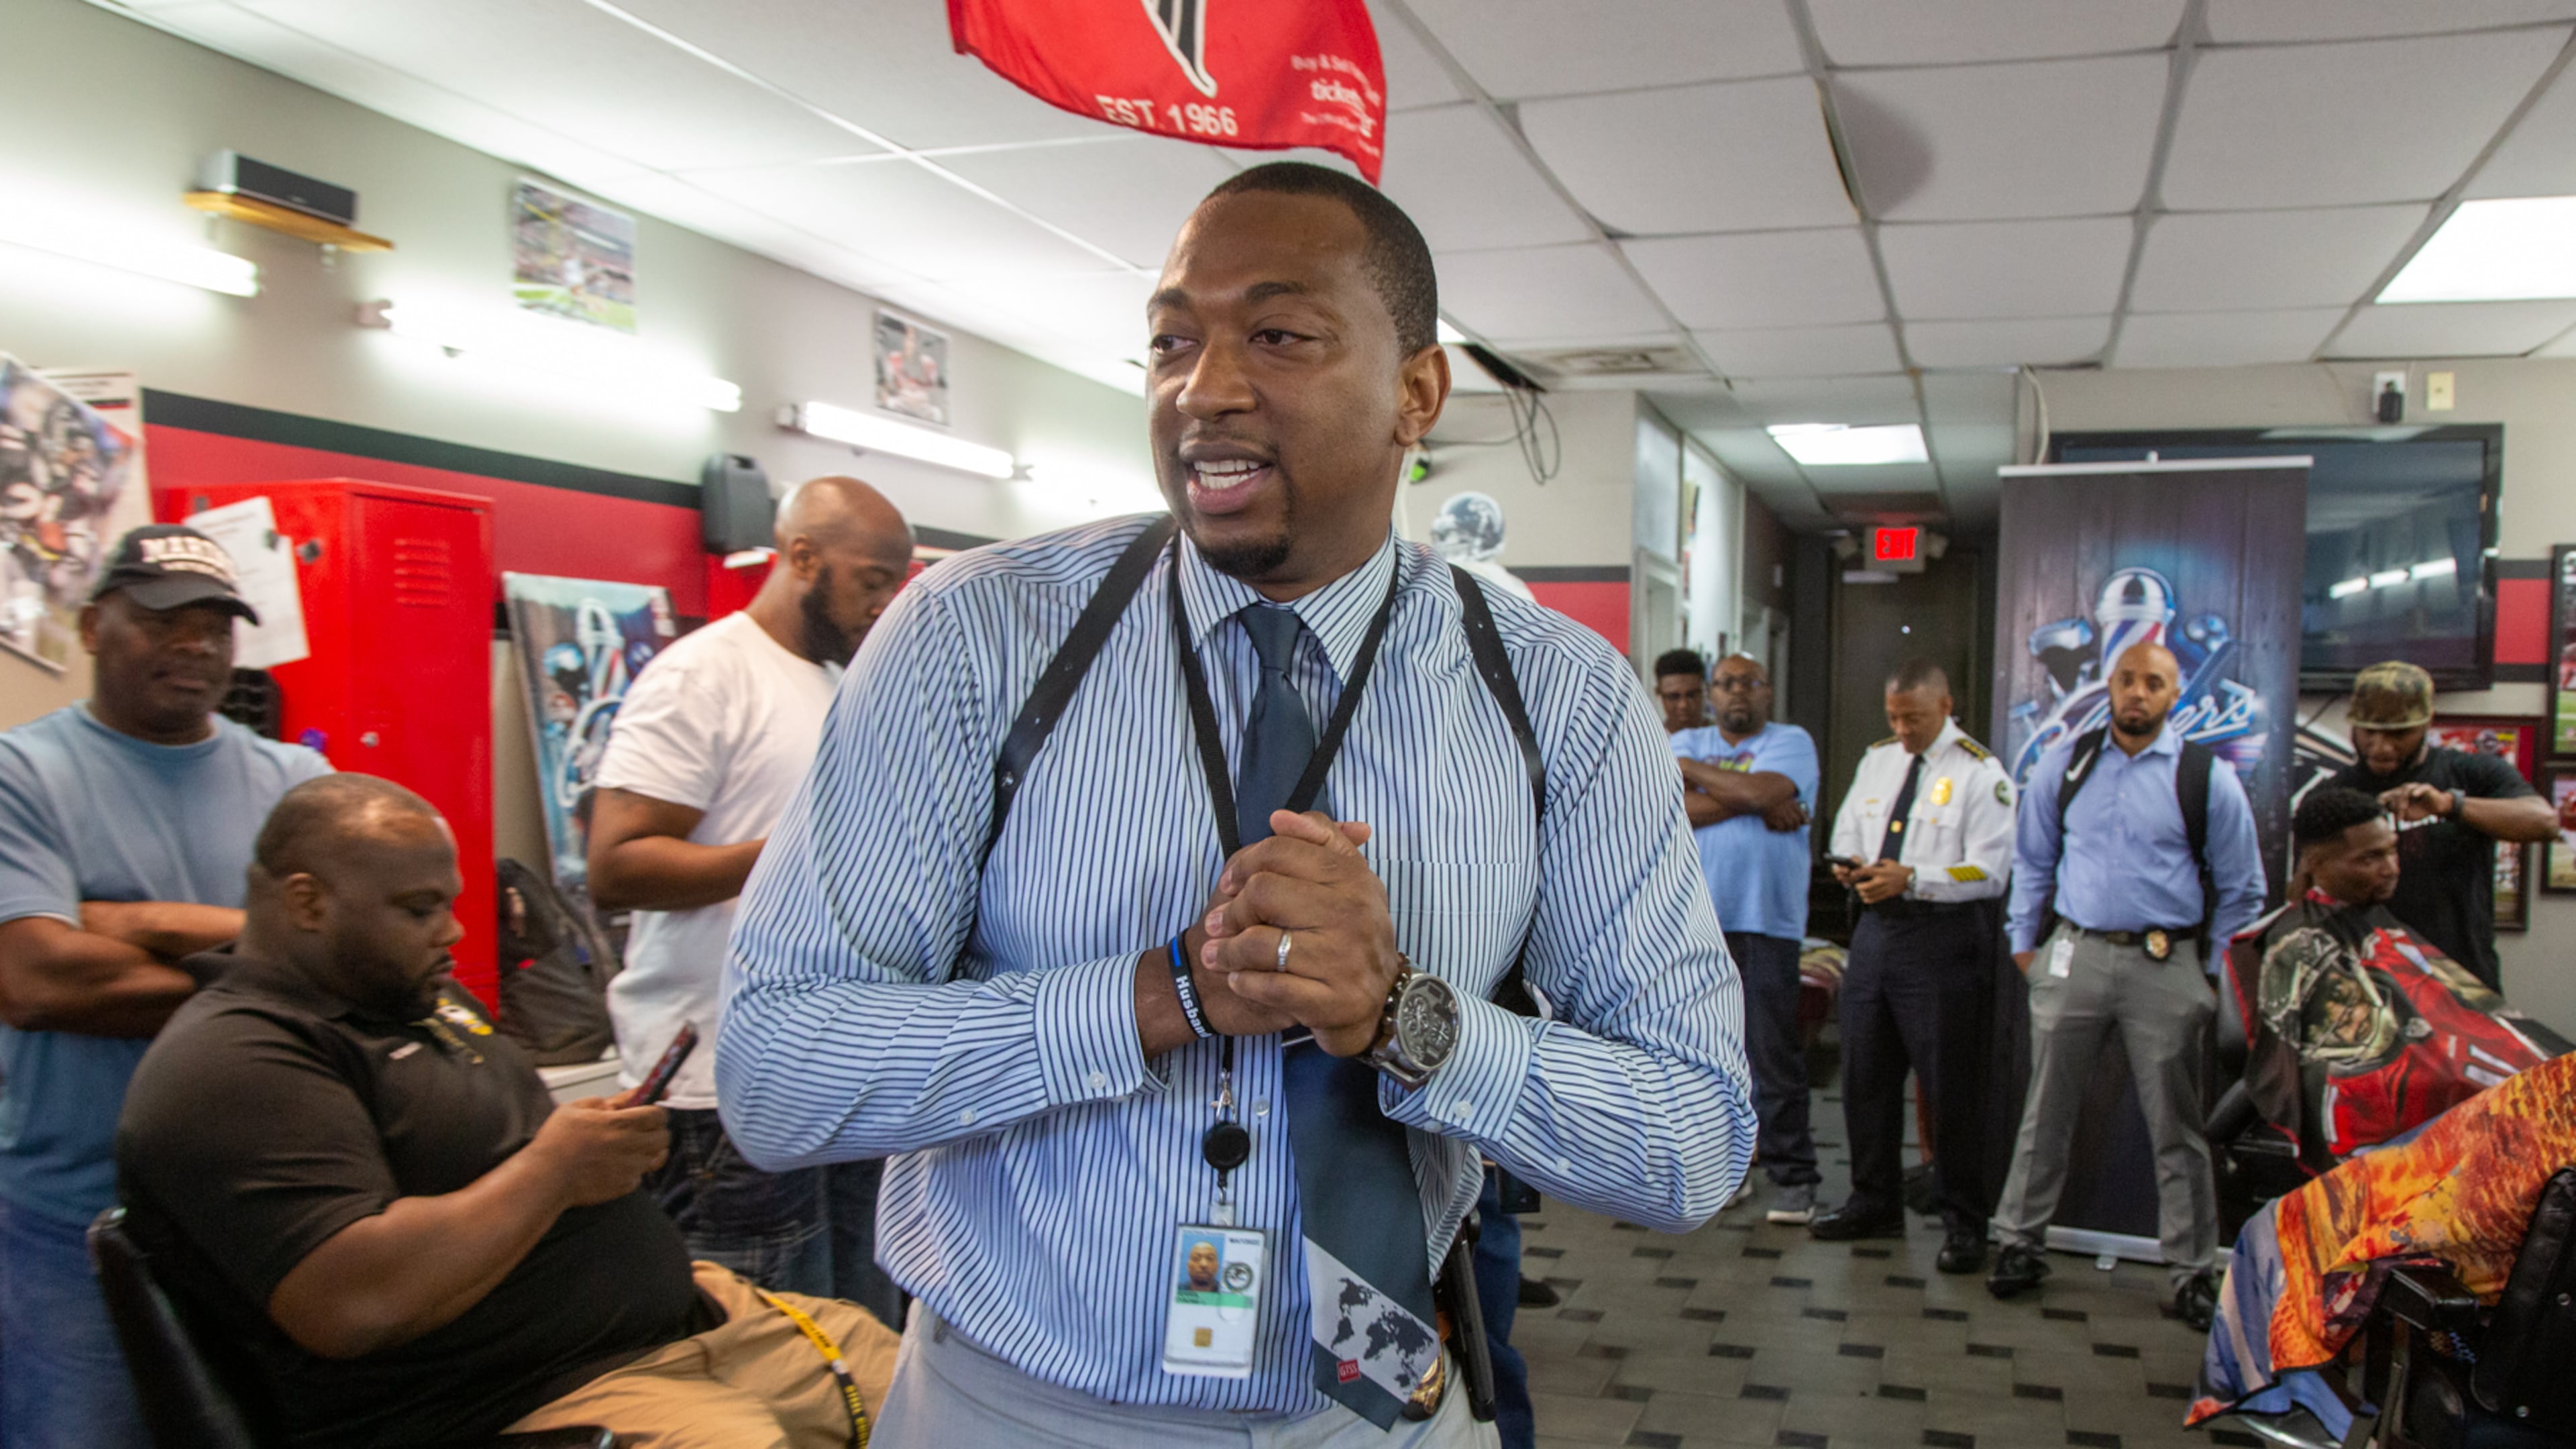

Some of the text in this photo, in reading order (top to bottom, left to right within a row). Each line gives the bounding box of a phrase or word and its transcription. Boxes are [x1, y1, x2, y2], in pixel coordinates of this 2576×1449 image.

[1095, 95, 1238, 136] EST. 1966
[1876, 528, 1918, 561] EXIT
